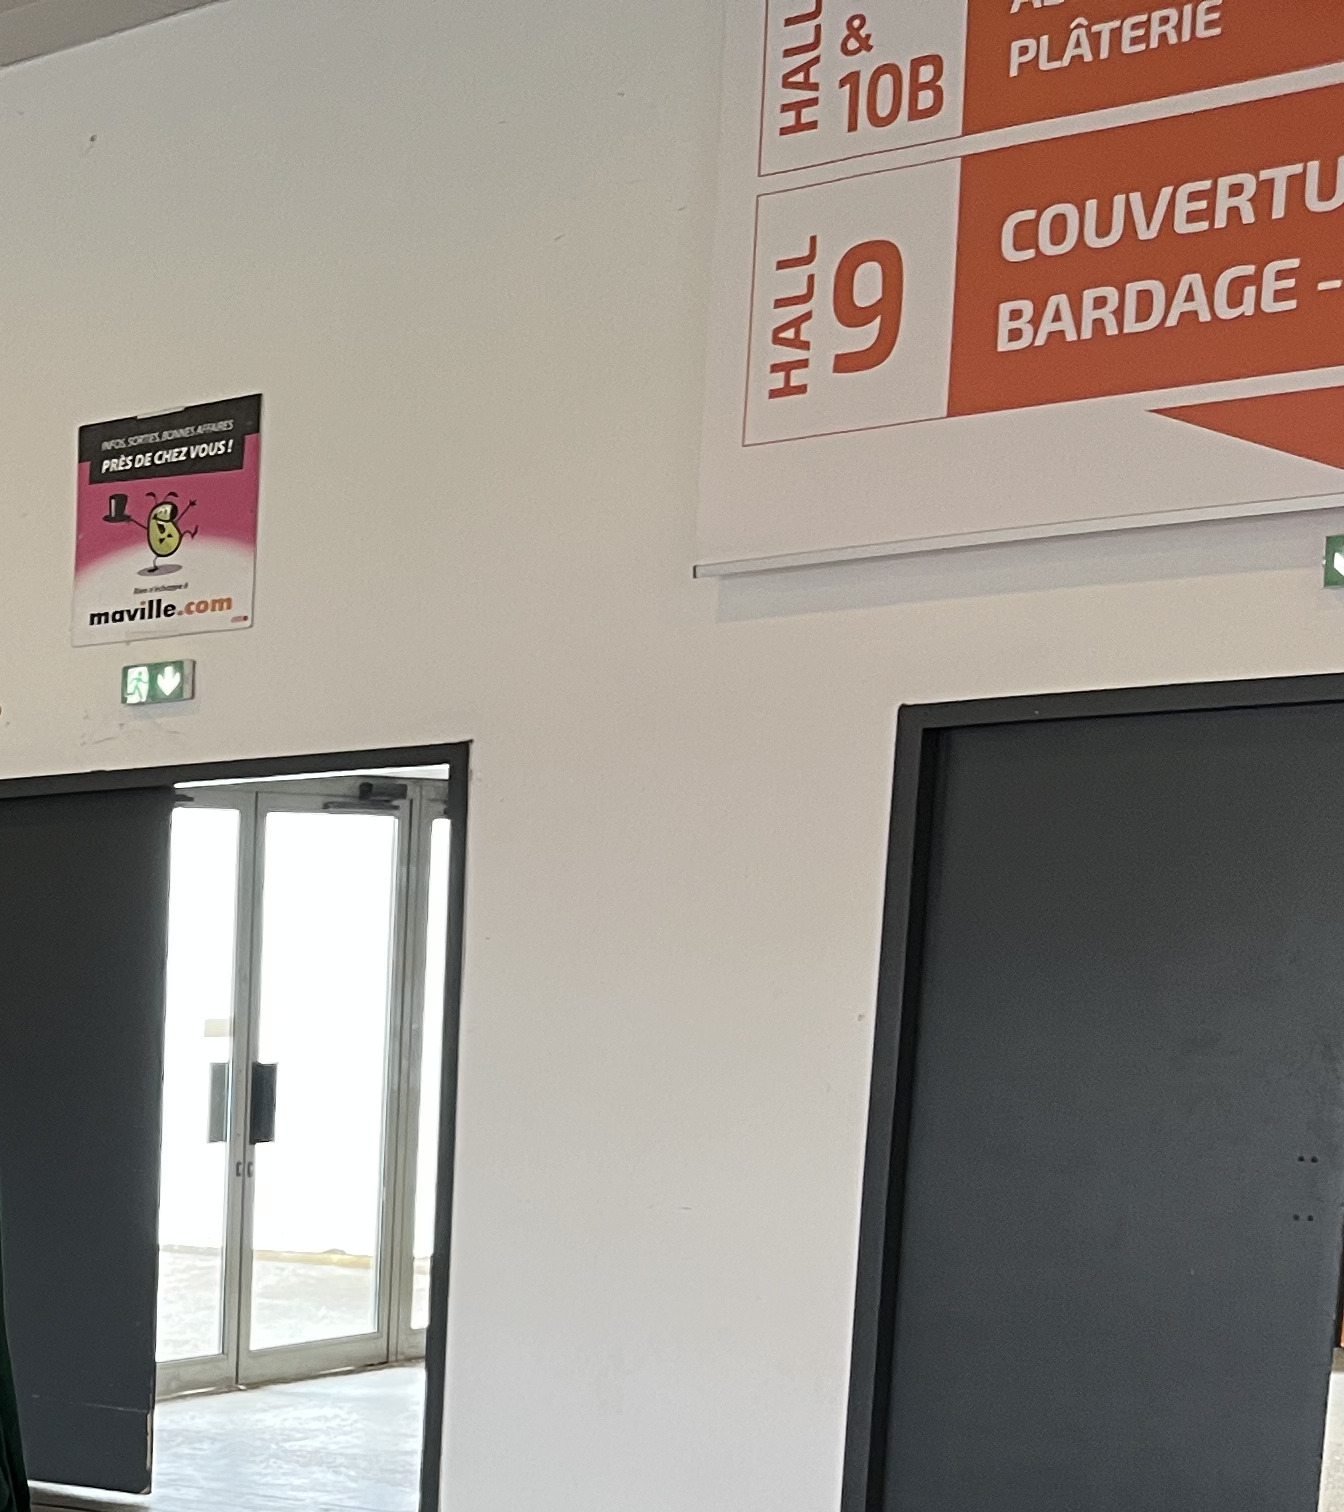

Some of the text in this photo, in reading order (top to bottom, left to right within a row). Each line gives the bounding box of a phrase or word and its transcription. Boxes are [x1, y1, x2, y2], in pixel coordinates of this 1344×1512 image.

[779, 0, 823, 136] HALL
[840, 13, 874, 57] &
[1009, 0, 1223, 77] PLÂTERIE
[838, 54, 944, 133] 10B
[1000, 155, 1344, 262] COUVERTU
[768, 235, 817, 400] HALL
[832, 239, 904, 375] 9
[997, 257, 1301, 352] BARDAGE
[101, 454, 133, 474] PRÈS
[134, 452, 153, 468] DE
[153, 447, 188, 465] CHEZ
[189, 440, 226, 459] VOUS
[88, 596, 233, 626] maville.com
